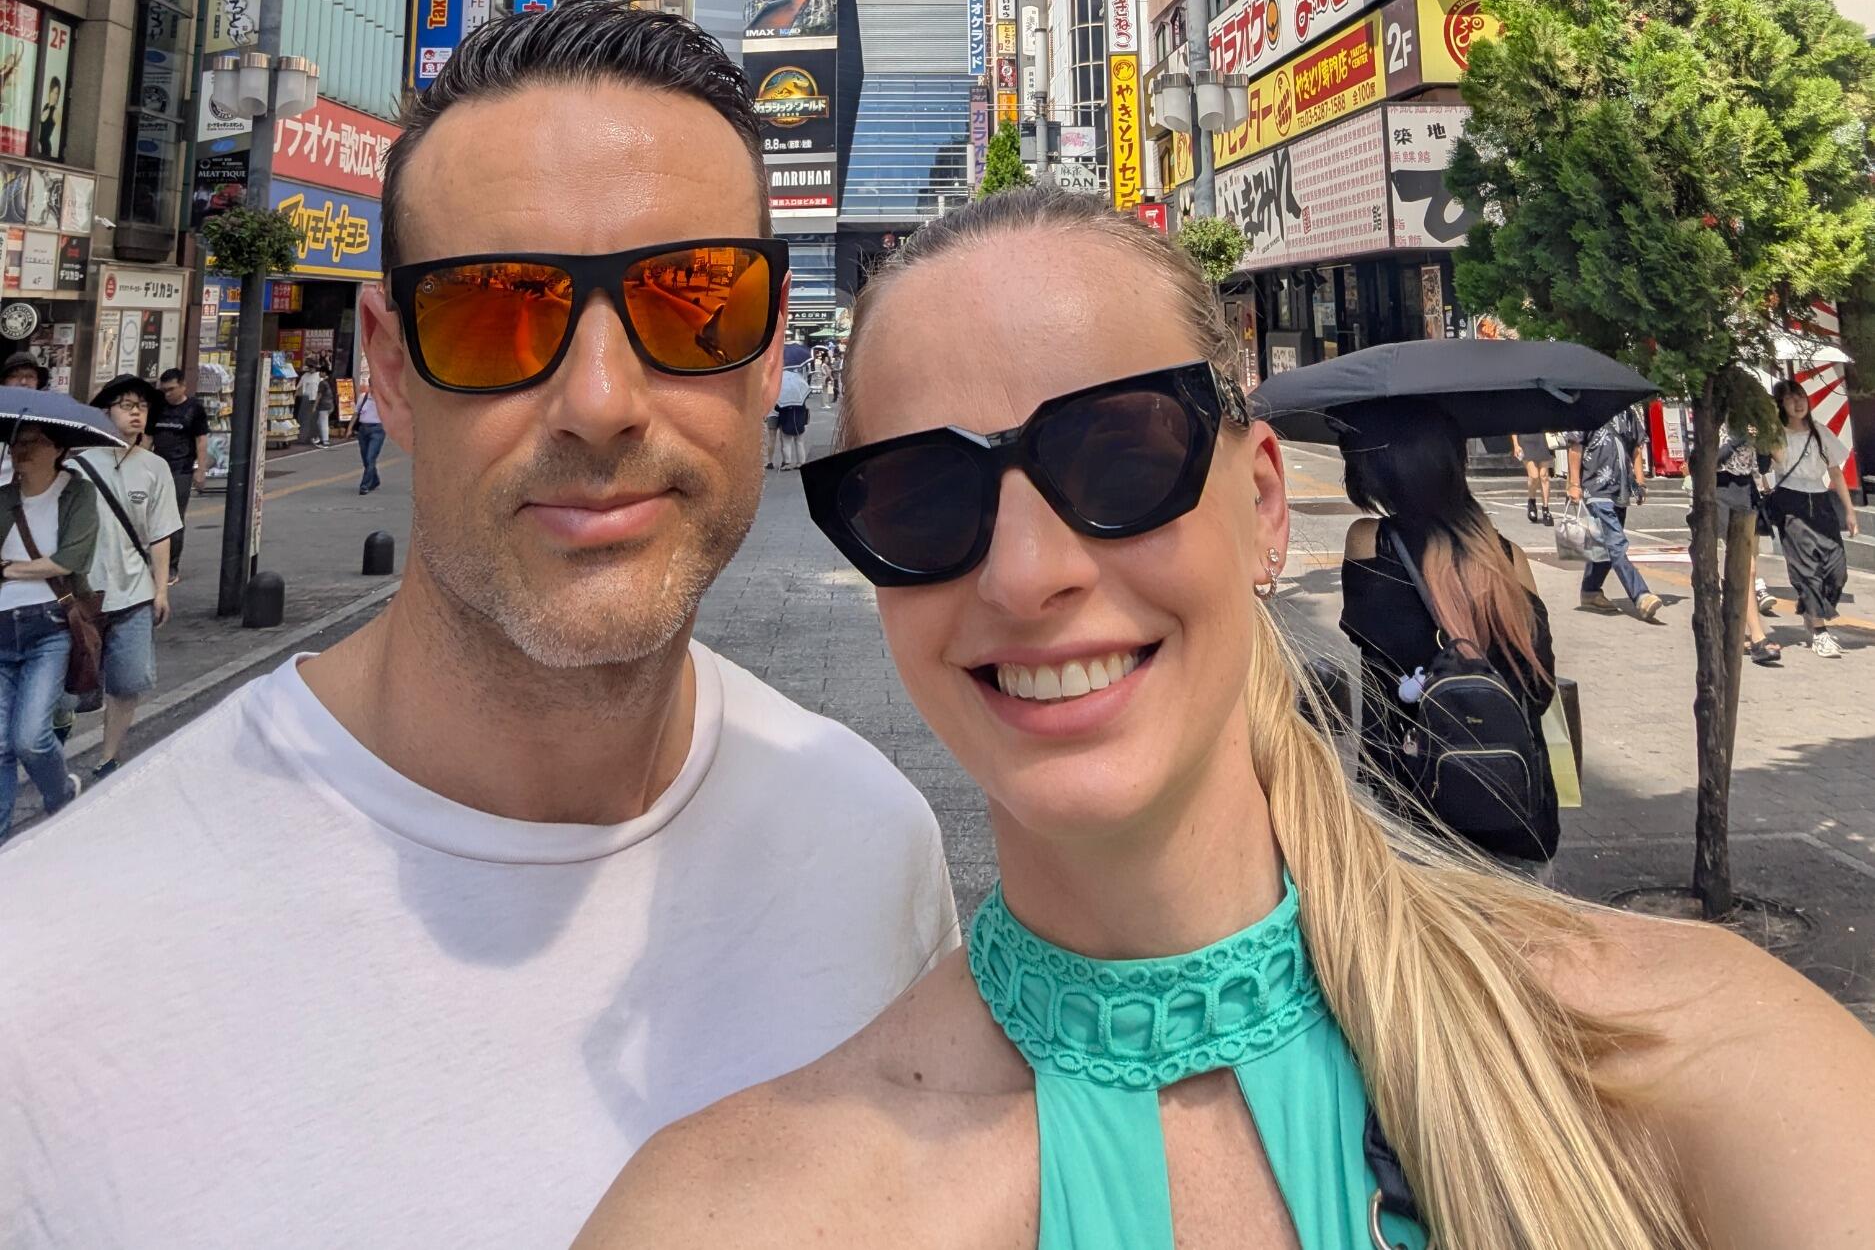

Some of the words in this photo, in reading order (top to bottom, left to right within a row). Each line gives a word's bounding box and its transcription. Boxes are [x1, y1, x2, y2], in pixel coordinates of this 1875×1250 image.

[50, 27, 67, 50] 2F
[746, 29, 775, 37] IMAX
[1387, 21, 1412, 74] 2F
[1295, 50, 1348, 101] やきとり専門店
[1352, 82, 1376, 106] 全100席
[1394, 123, 1447, 146] 築地
[764, 138, 780, 150] 8.8
[771, 169, 832, 187] MARUHAN
[1060, 177, 1094, 188] DAN
[143, 281, 180, 299] デリカシー
[57, 375, 69, 386] B1
